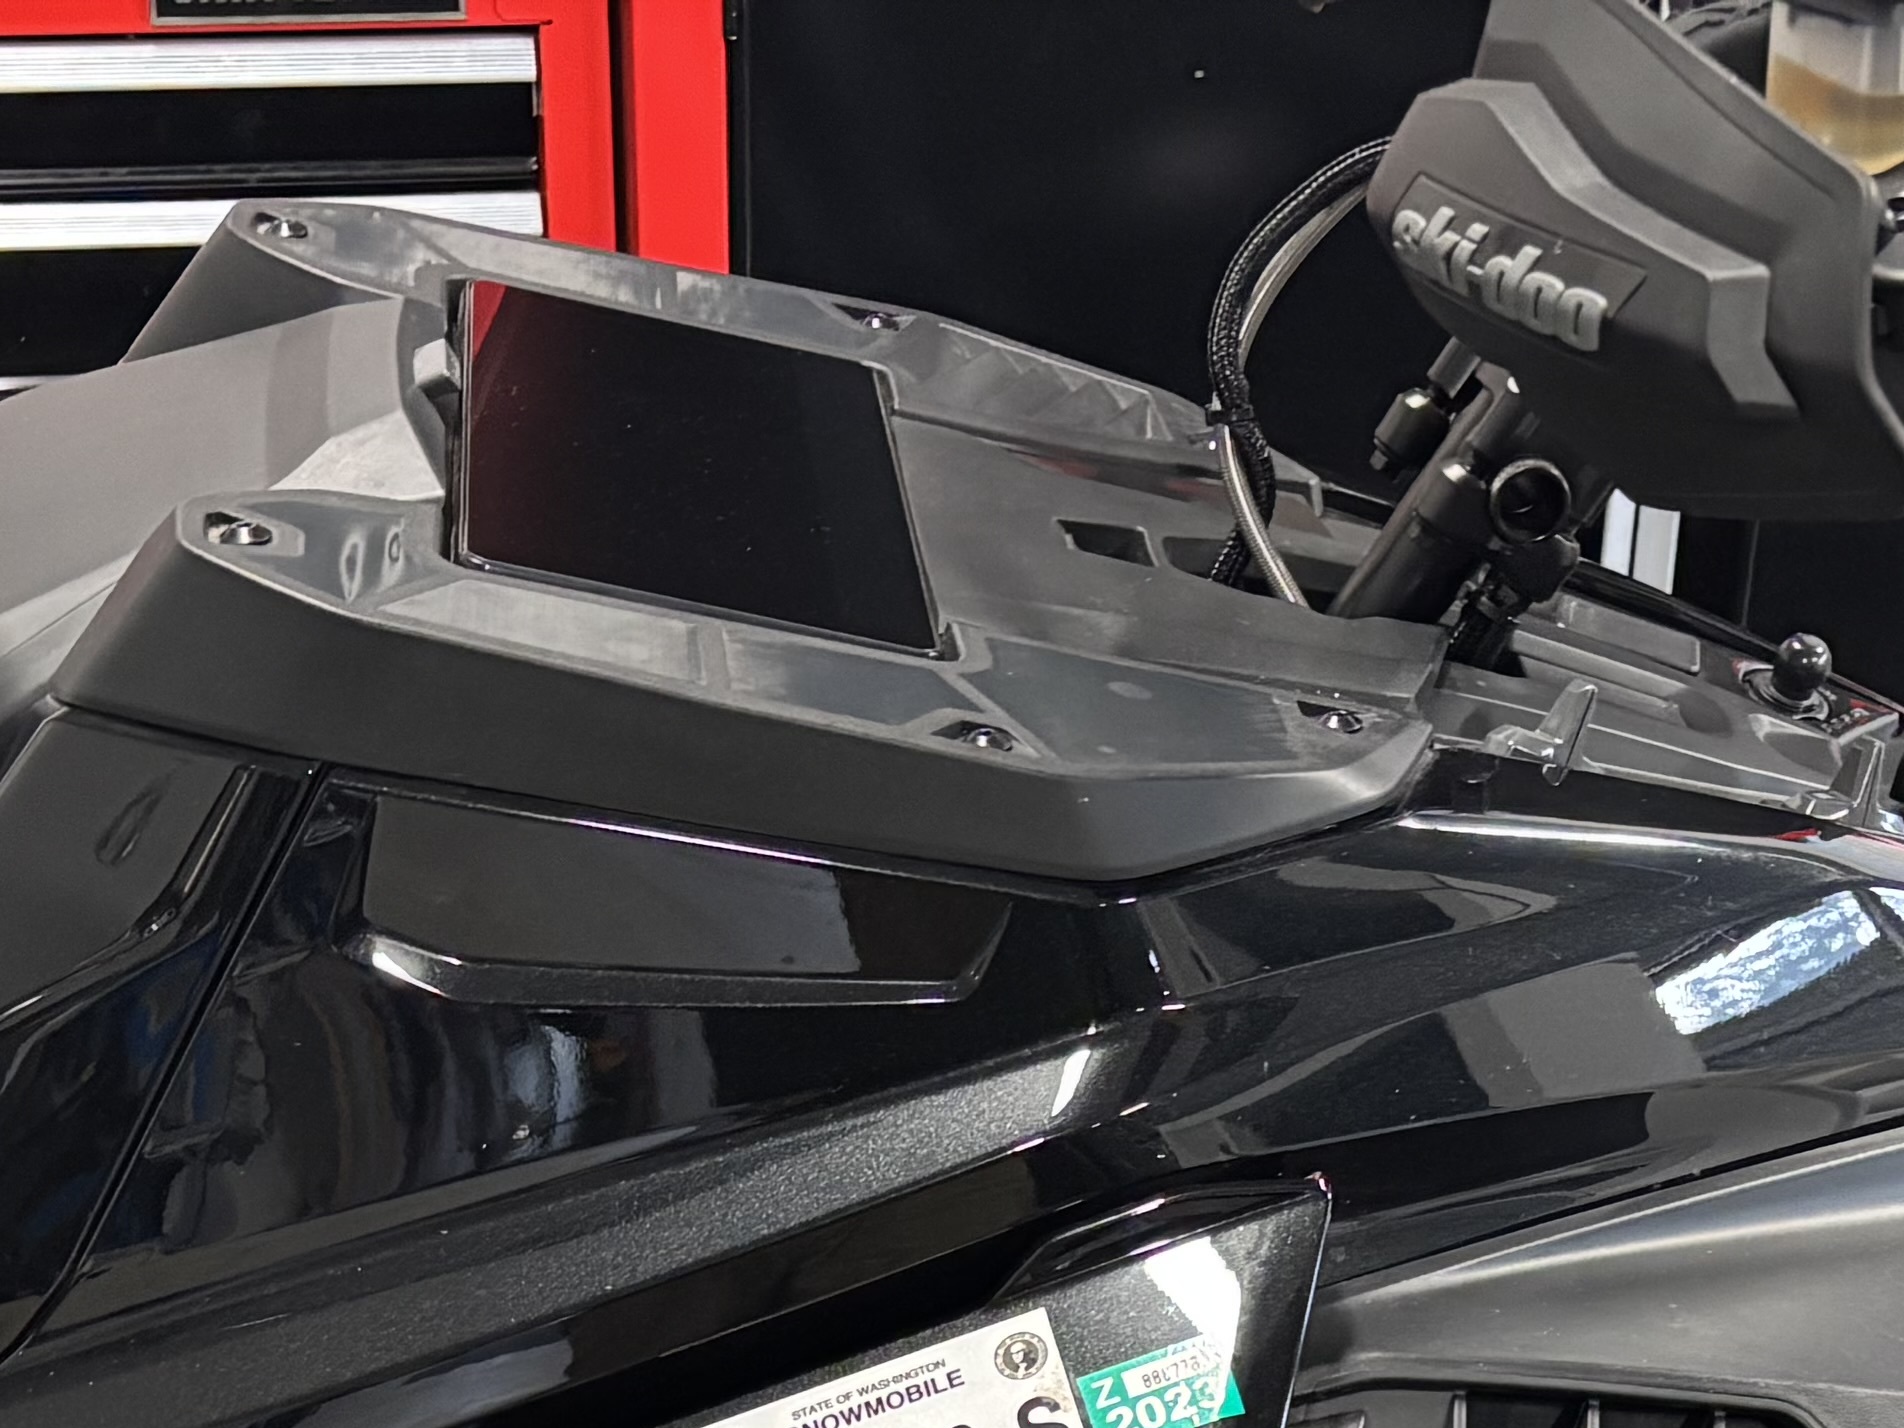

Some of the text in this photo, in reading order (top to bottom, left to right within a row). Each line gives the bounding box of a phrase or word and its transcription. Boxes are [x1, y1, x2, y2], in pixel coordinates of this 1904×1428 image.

[1392, 206, 1608, 352] ski-doo
[791, 1358, 947, 1422] STATE OF WASHINGTON
[1090, 1376, 1121, 1410] Z
